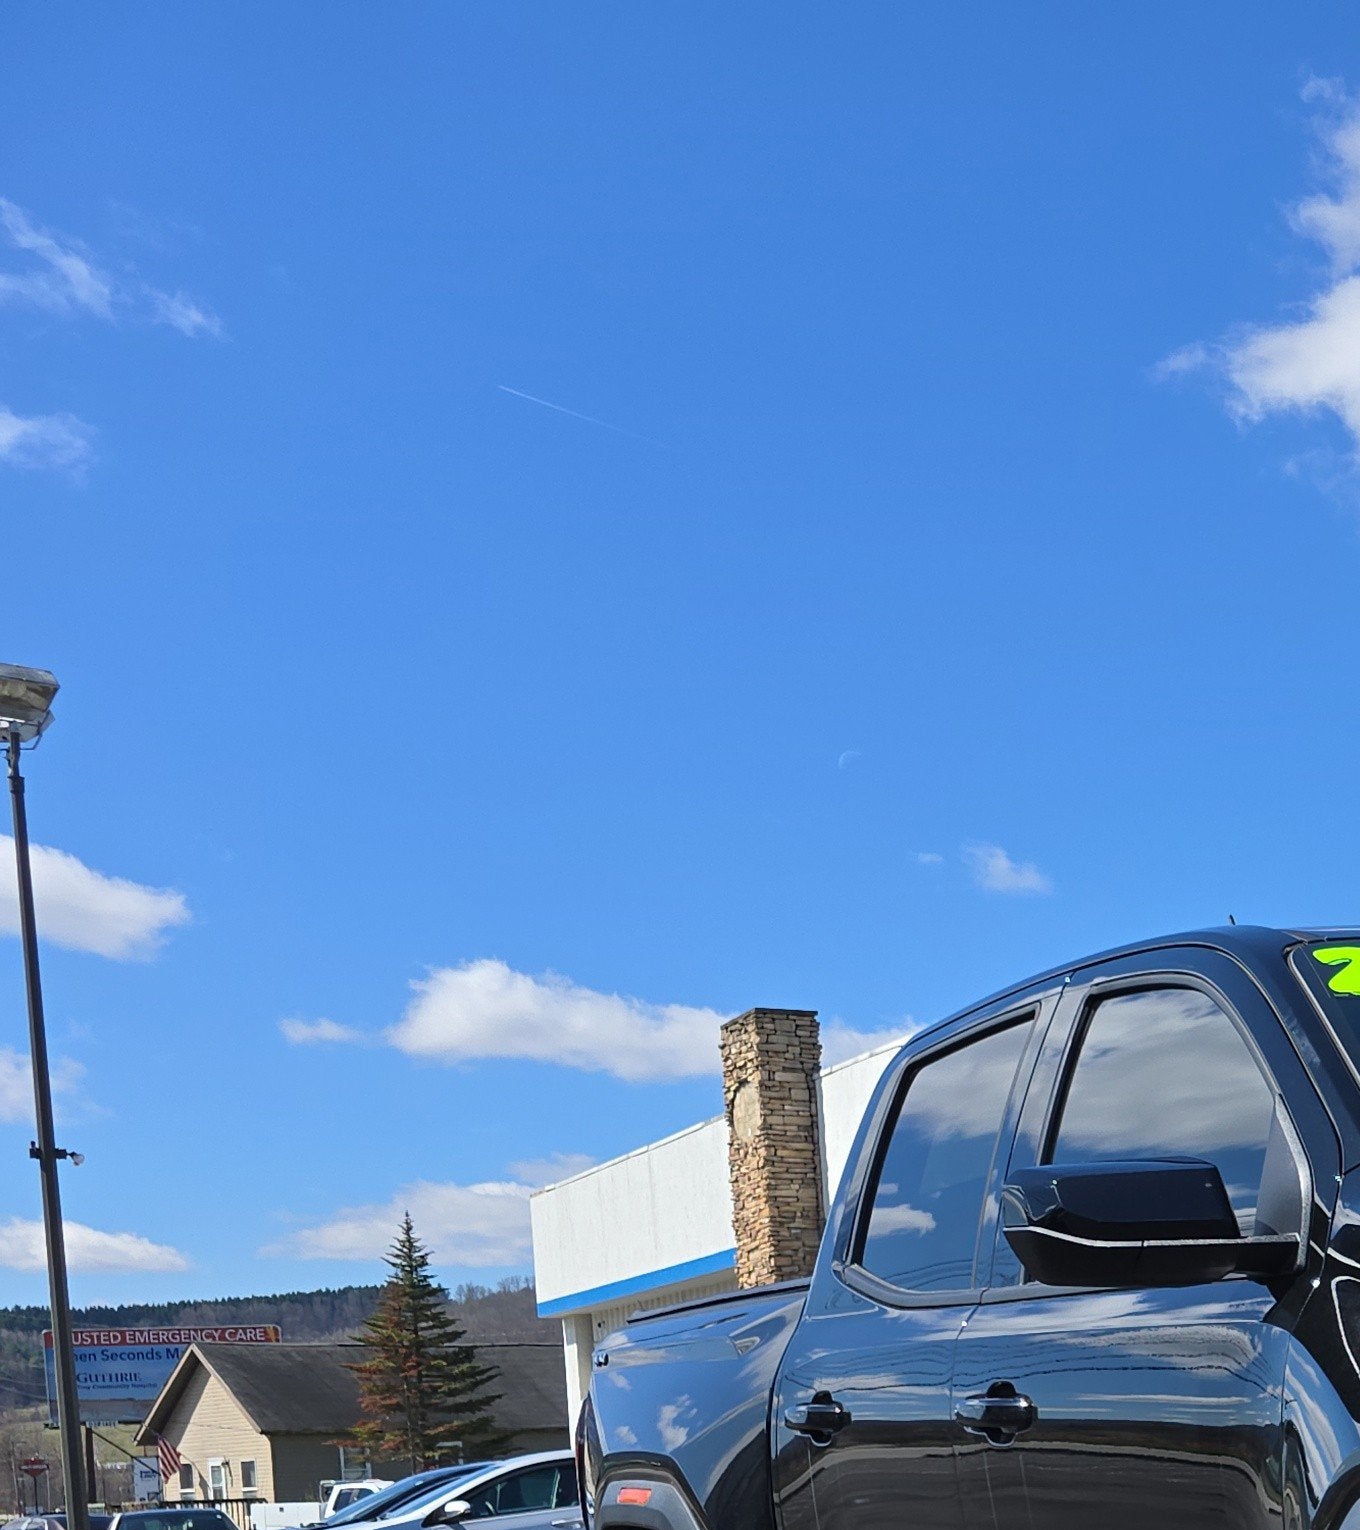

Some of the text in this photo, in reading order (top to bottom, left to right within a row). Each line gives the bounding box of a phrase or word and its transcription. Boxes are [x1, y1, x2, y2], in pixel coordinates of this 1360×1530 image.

[72, 1328, 266, 1345] USTED EMERGENCY CARE
[101, 1347, 162, 1362] Seconds
